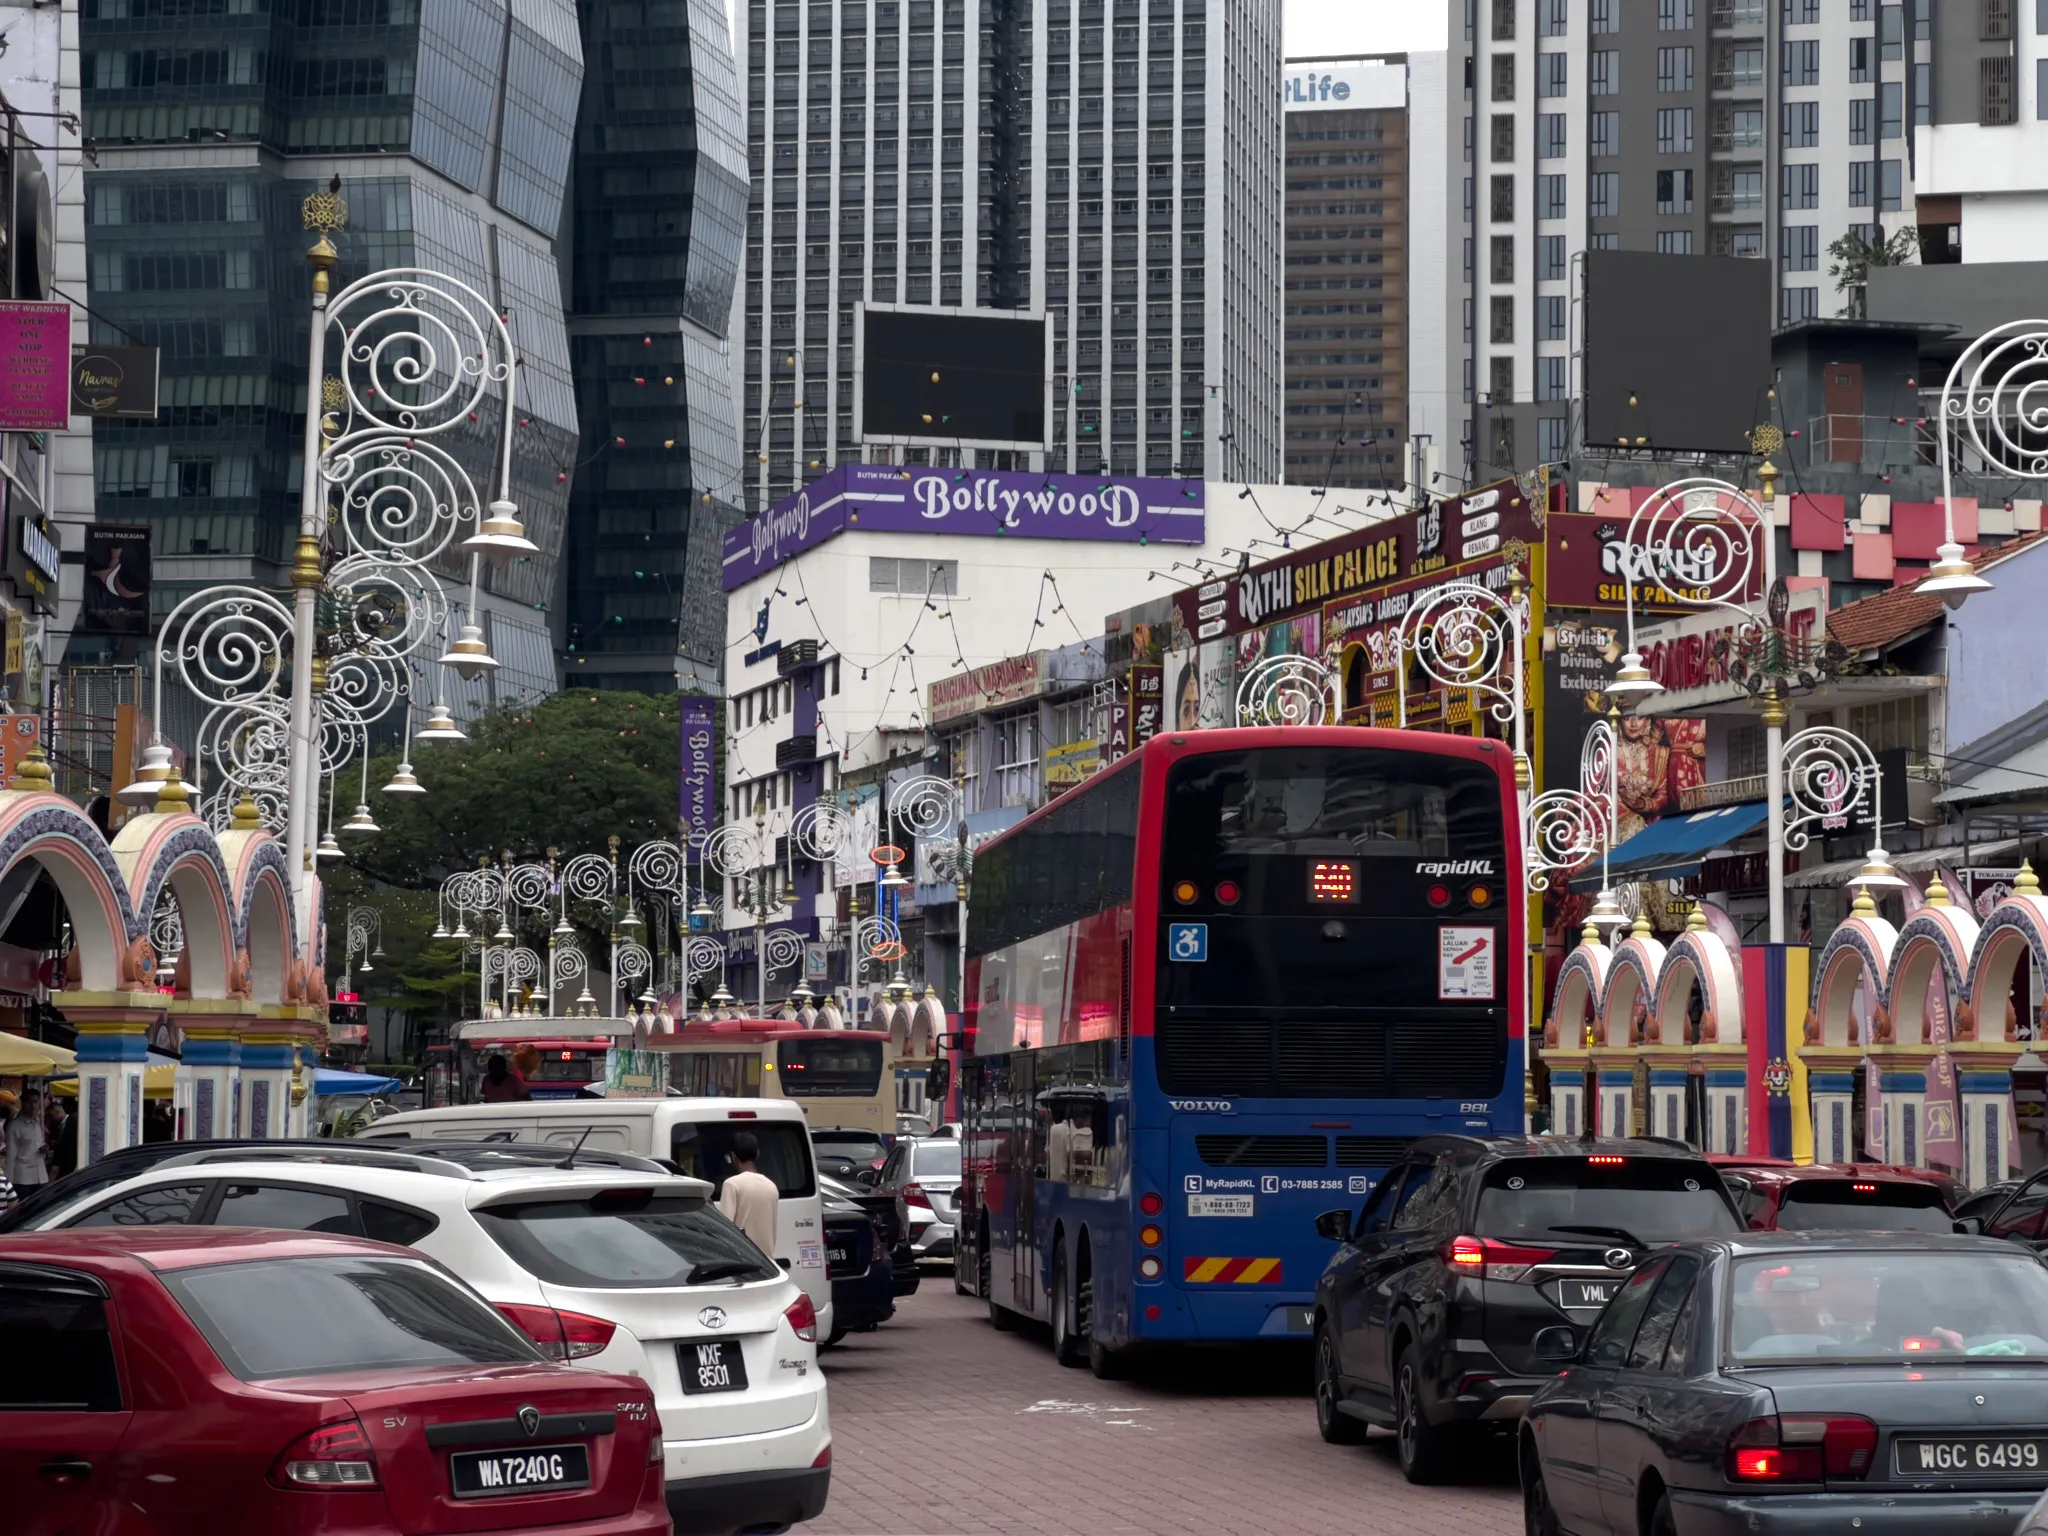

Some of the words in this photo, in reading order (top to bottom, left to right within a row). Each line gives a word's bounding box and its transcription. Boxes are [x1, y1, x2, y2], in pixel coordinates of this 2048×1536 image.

[18, 317, 45, 326] YOUR
[20, 331, 40, 339] ONE
[18, 343, 42, 352] STOP
[1472, 496, 1485, 509] IPOH
[1470, 518, 1488, 532] KLANG
[115, 531, 146, 540] PAKAIAN
[1468, 538, 1490, 554] PENANG
[1239, 565, 1292, 624] RATHI
[1295, 559, 1330, 604] SILK
[1334, 536, 1398, 592] PALACE
[1599, 583, 1638, 602] SILK
[1377, 592, 1410, 621] LARGEST
[1560, 628, 1606, 649] Stylish
[1560, 653, 1603, 669] Divine
[1372, 676, 1389, 688] SINCE
[1559, 674, 1614, 691] Exclusiv
[19, 724, 33, 733] 24
[1416, 860, 1495, 878] rapidKL
[1168, 1100, 1232, 1112] VOLVO
[1205, 1179, 1256, 1189] MyRapidKL
[1281, 1179, 1319, 1190] 03-7885
[1320, 1179, 1343, 1190] 2585
[1581, 1285, 1609, 1302] VML
[696, 1343, 722, 1367] WXF
[698, 1364, 730, 1387] 8501
[383, 1416, 408, 1429] SV
[1919, 1443, 1968, 1469] WGC
[1975, 1443, 2039, 1468] 6499
